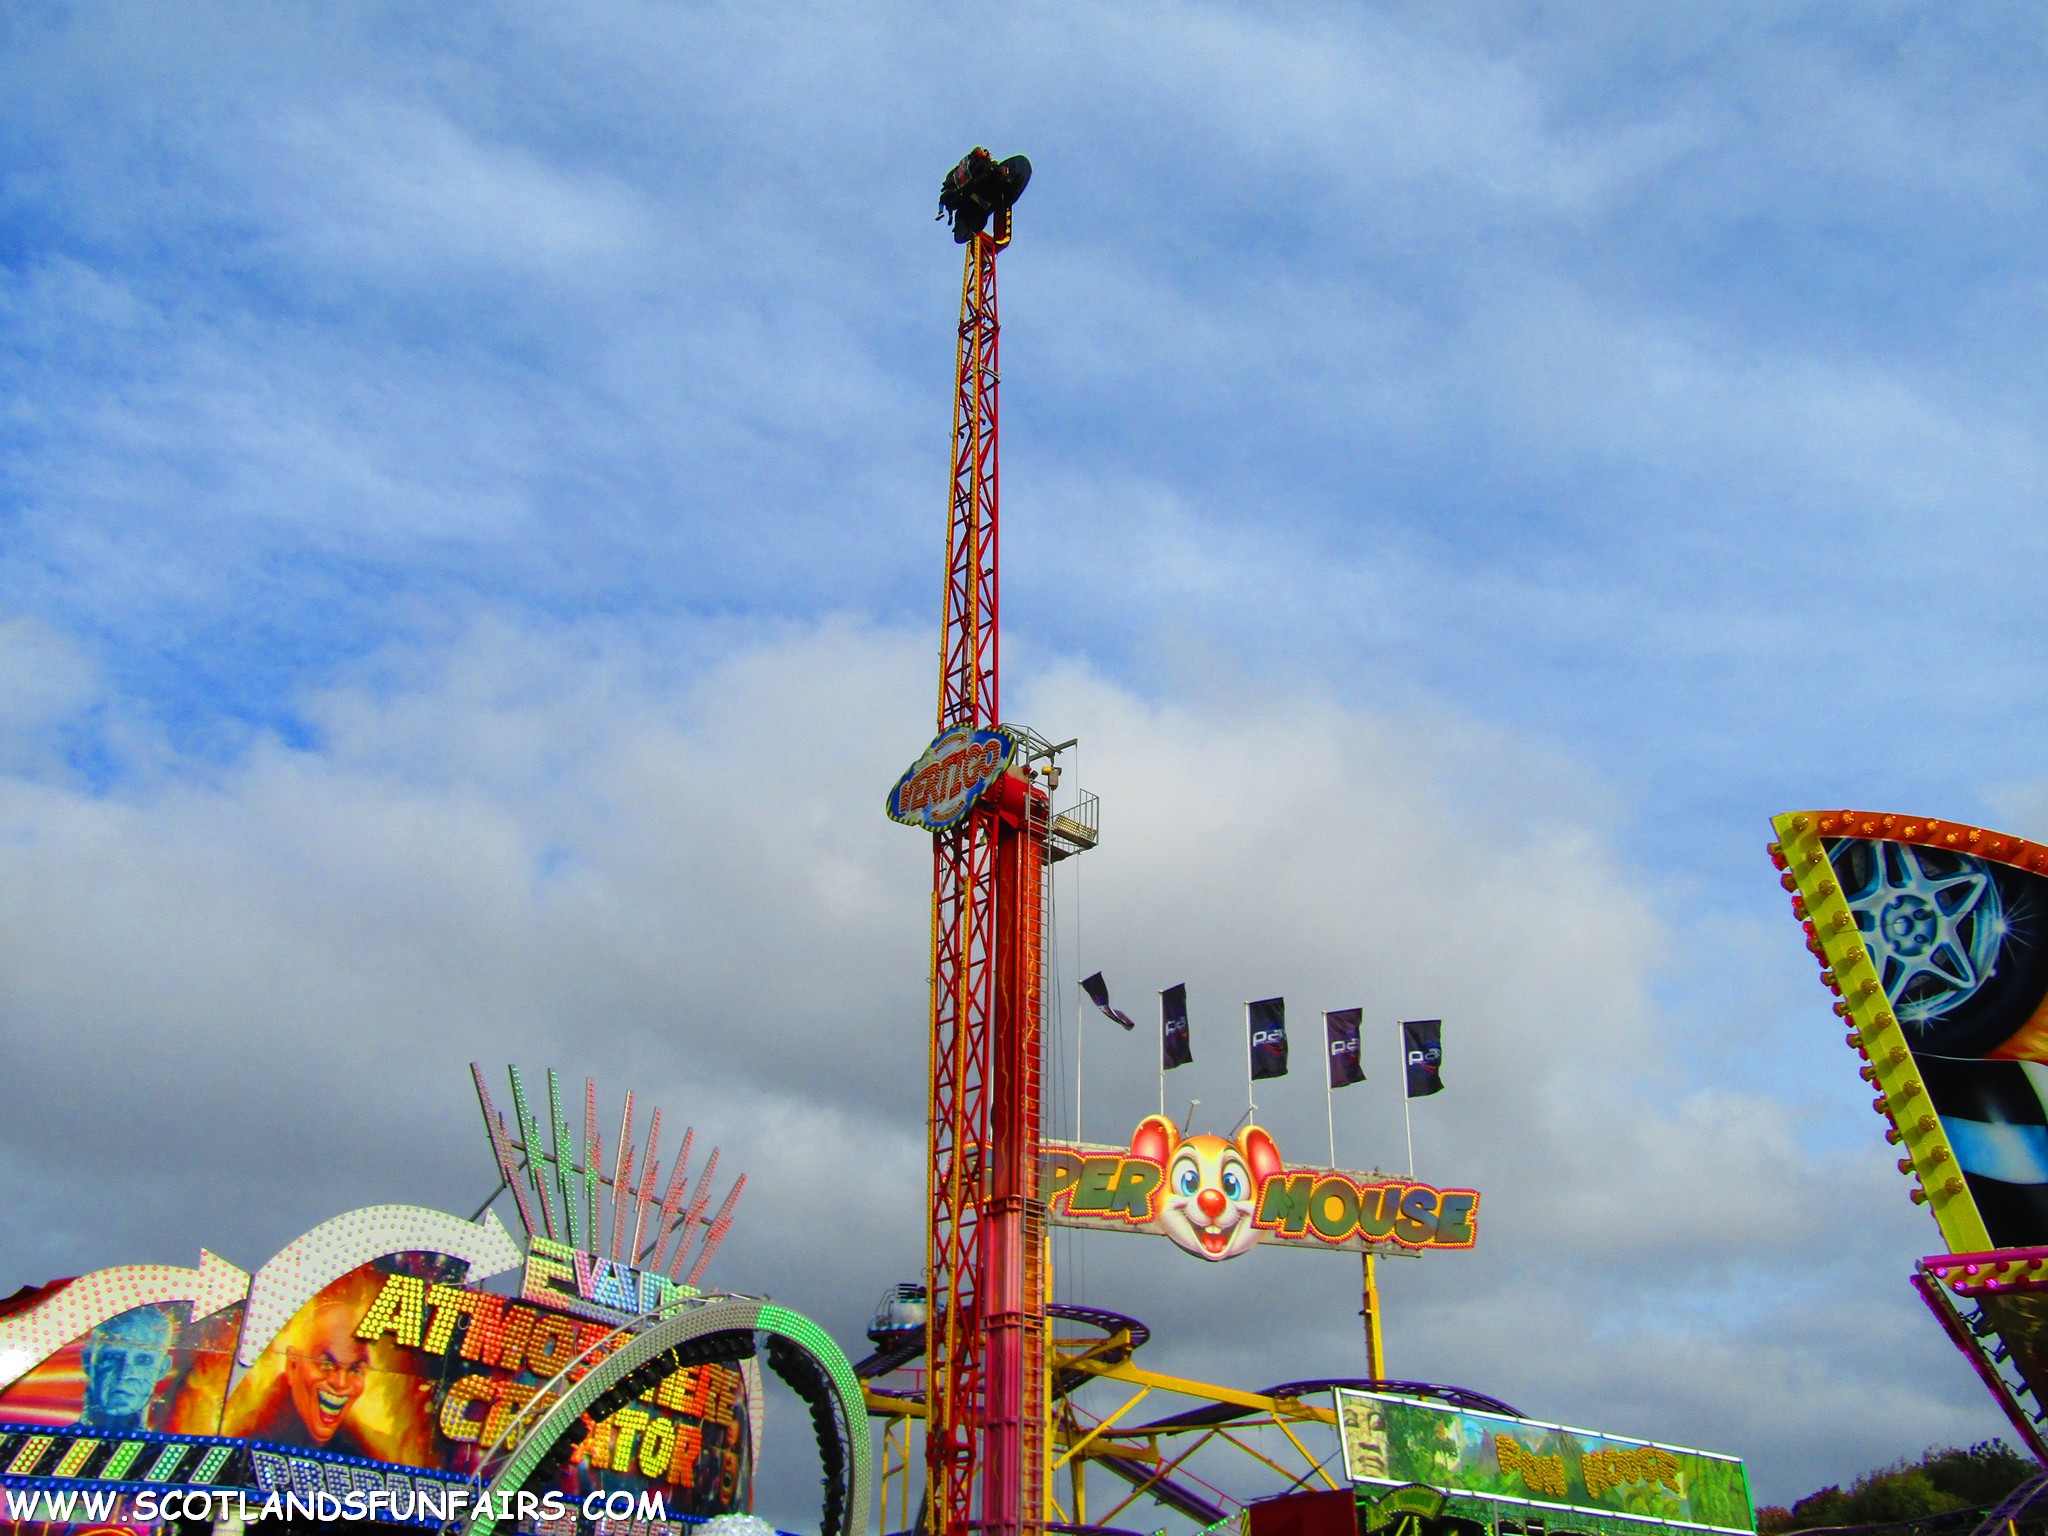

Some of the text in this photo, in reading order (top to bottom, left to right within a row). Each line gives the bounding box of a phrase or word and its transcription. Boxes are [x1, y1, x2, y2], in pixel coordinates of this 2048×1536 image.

[899, 739, 1002, 814] VERTIGO
[1252, 1171, 1480, 1248] MOUSE
[440, 1373, 703, 1489] CRATOR
